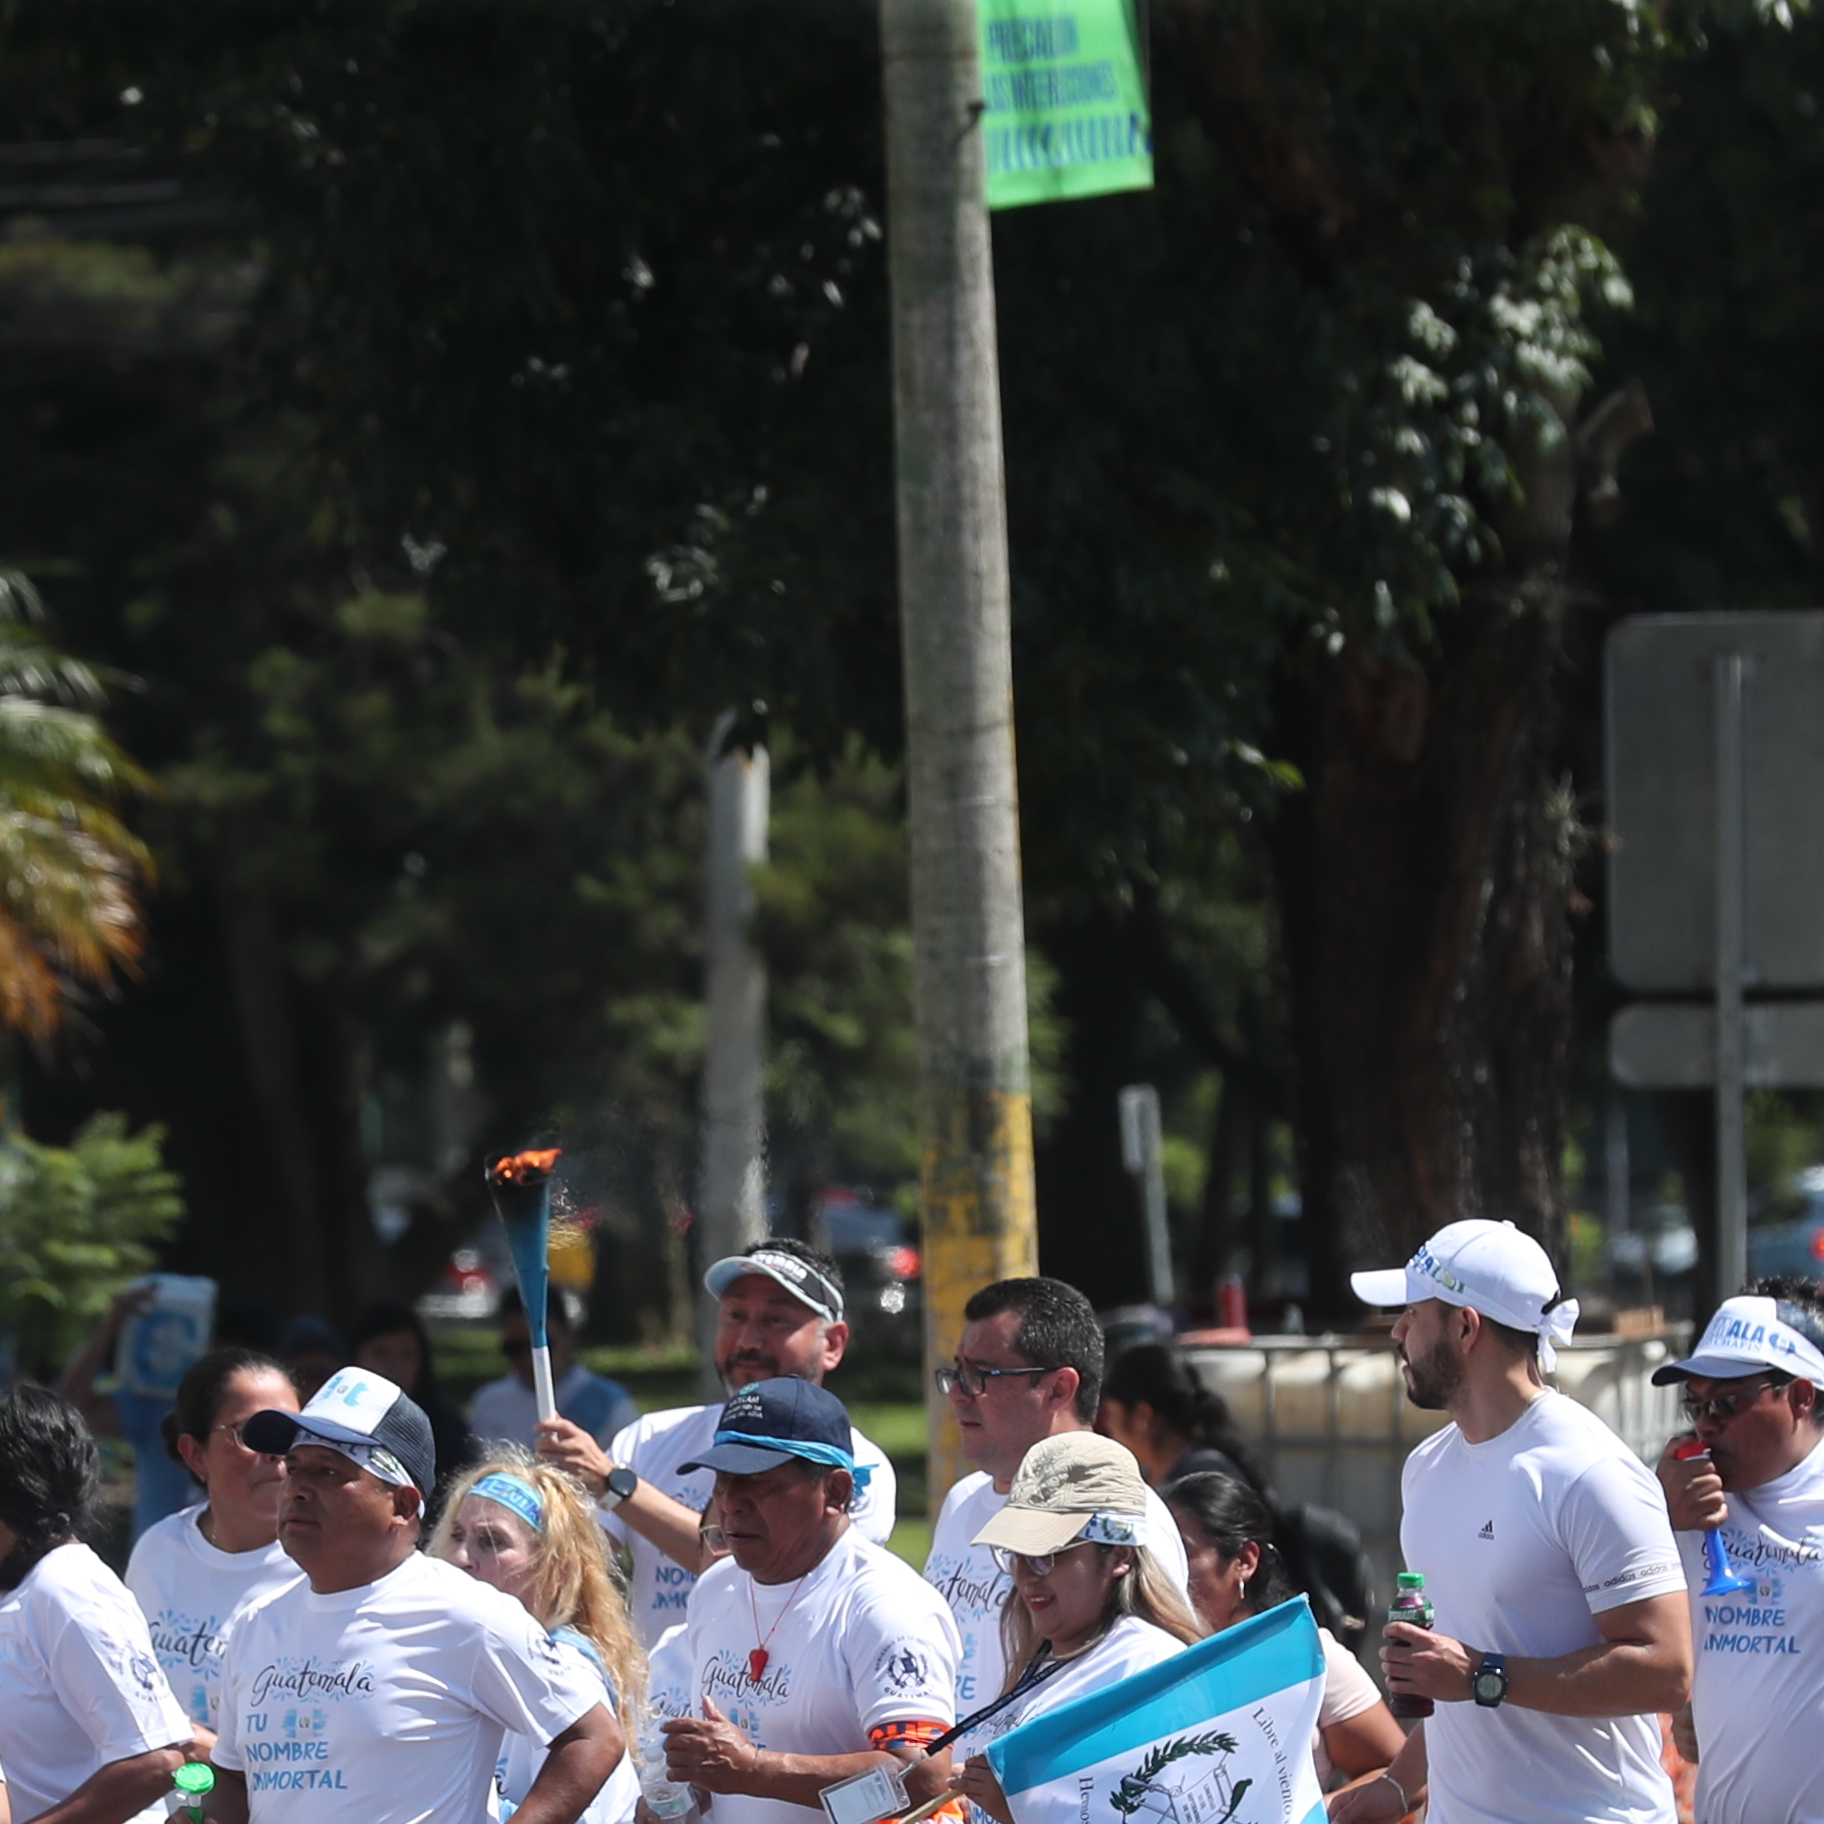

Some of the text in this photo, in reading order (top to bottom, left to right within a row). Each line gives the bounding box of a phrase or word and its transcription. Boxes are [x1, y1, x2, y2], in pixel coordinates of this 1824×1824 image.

[1604, 1573, 1636, 1587] adidas
[1704, 1605, 1786, 1627] NOMBRE
[1703, 1633, 1801, 1655] INMORTAL
[250, 1660, 376, 1708] Guatemala
[246, 1713, 268, 1734] TU
[1251, 1706, 1280, 1749] Libre
[245, 1741, 330, 1763] NOMBRE
[1274, 1750, 1286, 1766] al
[1277, 1765, 1294, 1818] viento
